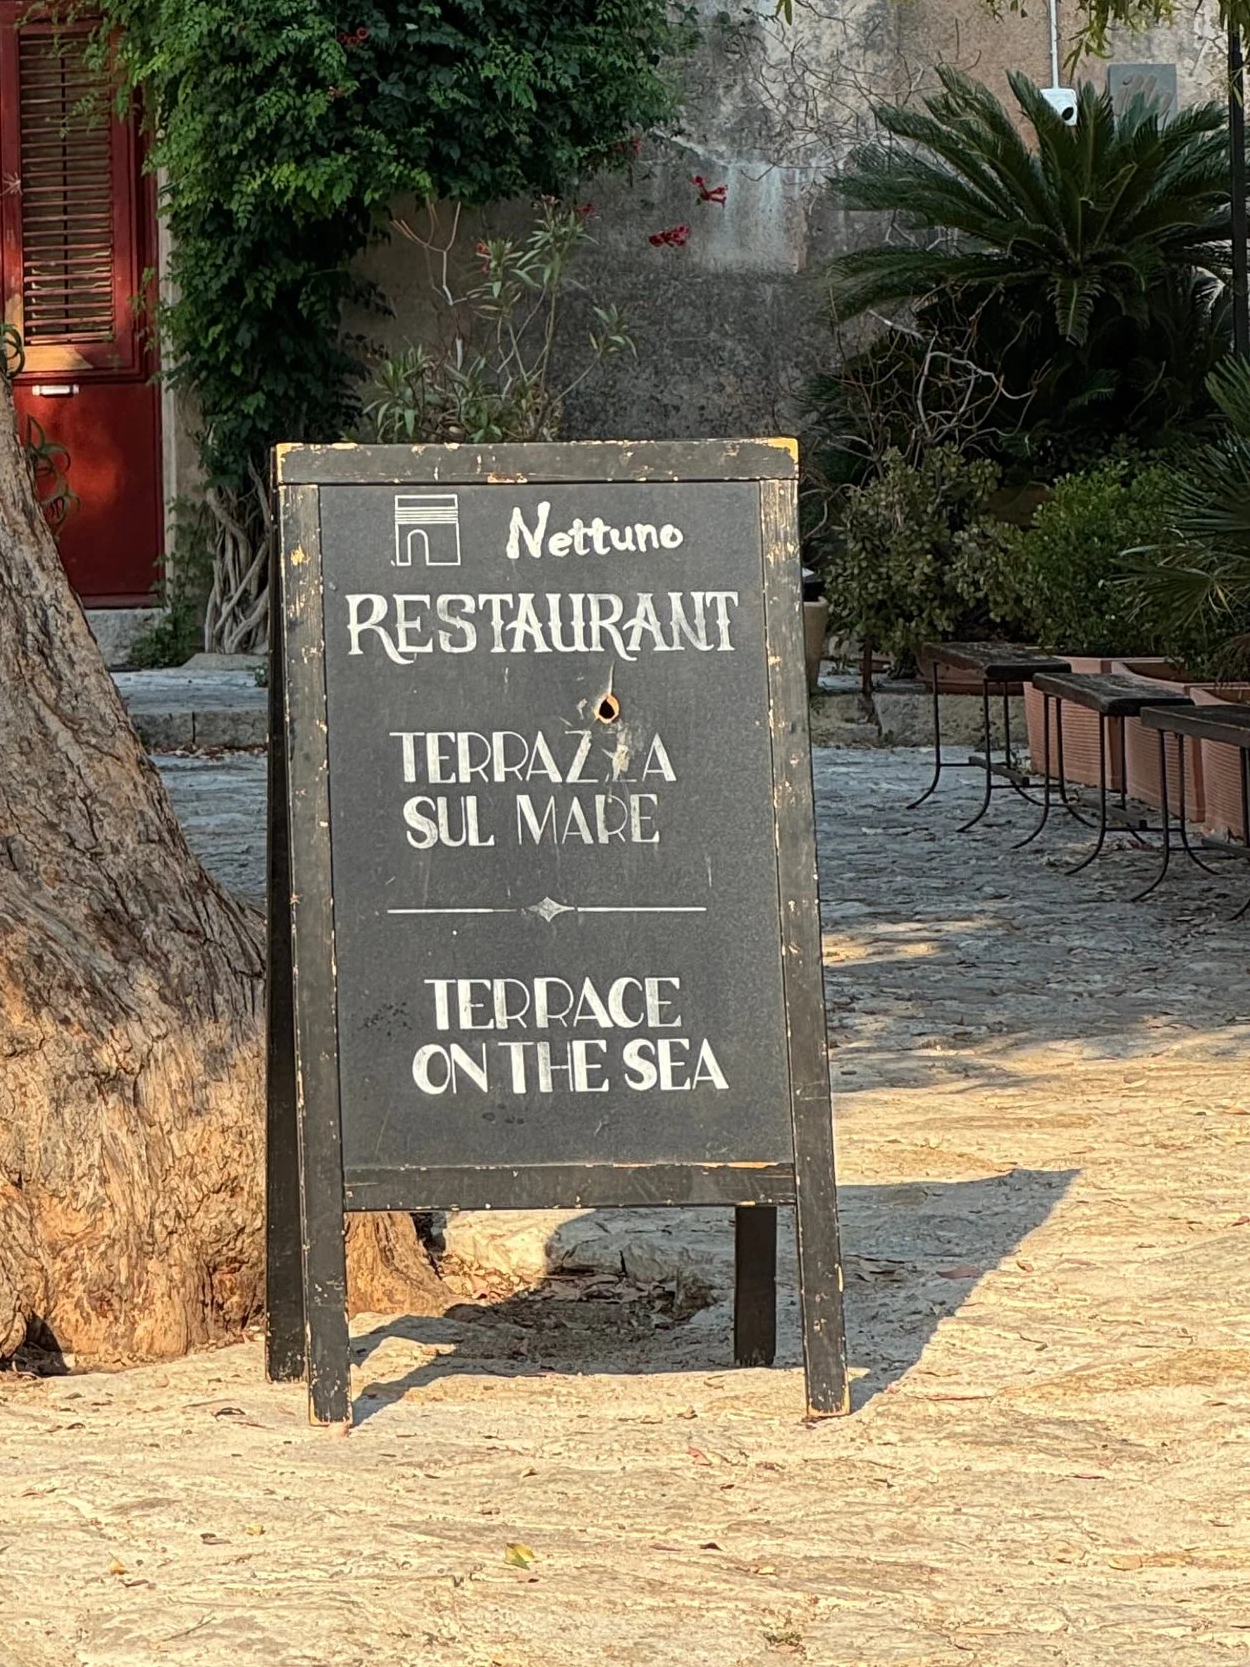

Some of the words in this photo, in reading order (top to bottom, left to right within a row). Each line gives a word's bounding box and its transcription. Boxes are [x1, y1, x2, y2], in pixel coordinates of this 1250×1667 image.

[506, 500, 684, 560] Nettuno
[345, 591, 739, 665] RESTAURANT
[402, 795, 495, 849] SUL
[516, 793, 660, 846] MARE
[423, 976, 682, 1031] TERRACE
[412, 1042, 489, 1095] ON
[498, 1039, 609, 1095] THE
[622, 1037, 730, 1092] SEA
